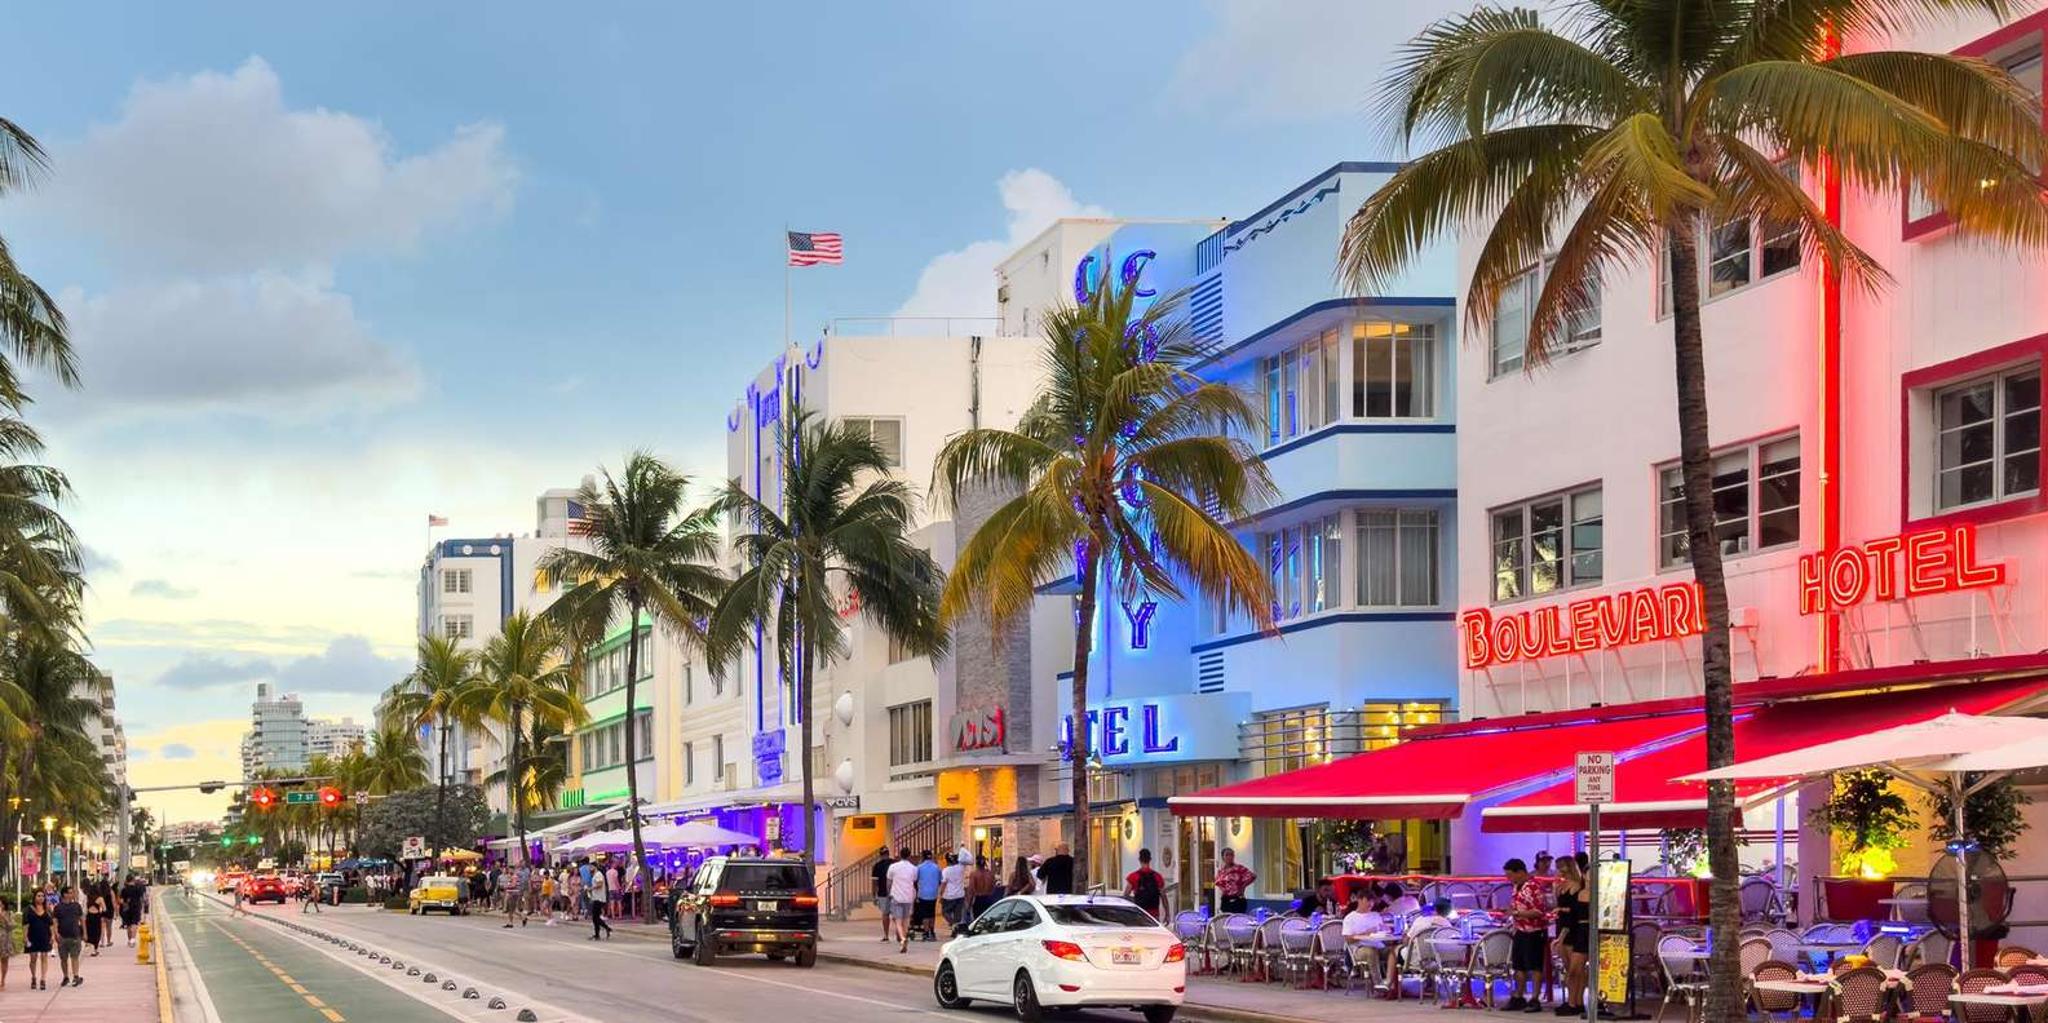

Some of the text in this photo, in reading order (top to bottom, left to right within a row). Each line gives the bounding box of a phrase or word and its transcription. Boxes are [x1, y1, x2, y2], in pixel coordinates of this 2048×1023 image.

[1799, 523, 2006, 617] HOTEL
[1588, 755, 1602, 764] NO
[1579, 765, 1611, 775] PARKING
[836, 797, 857, 807] CVS
